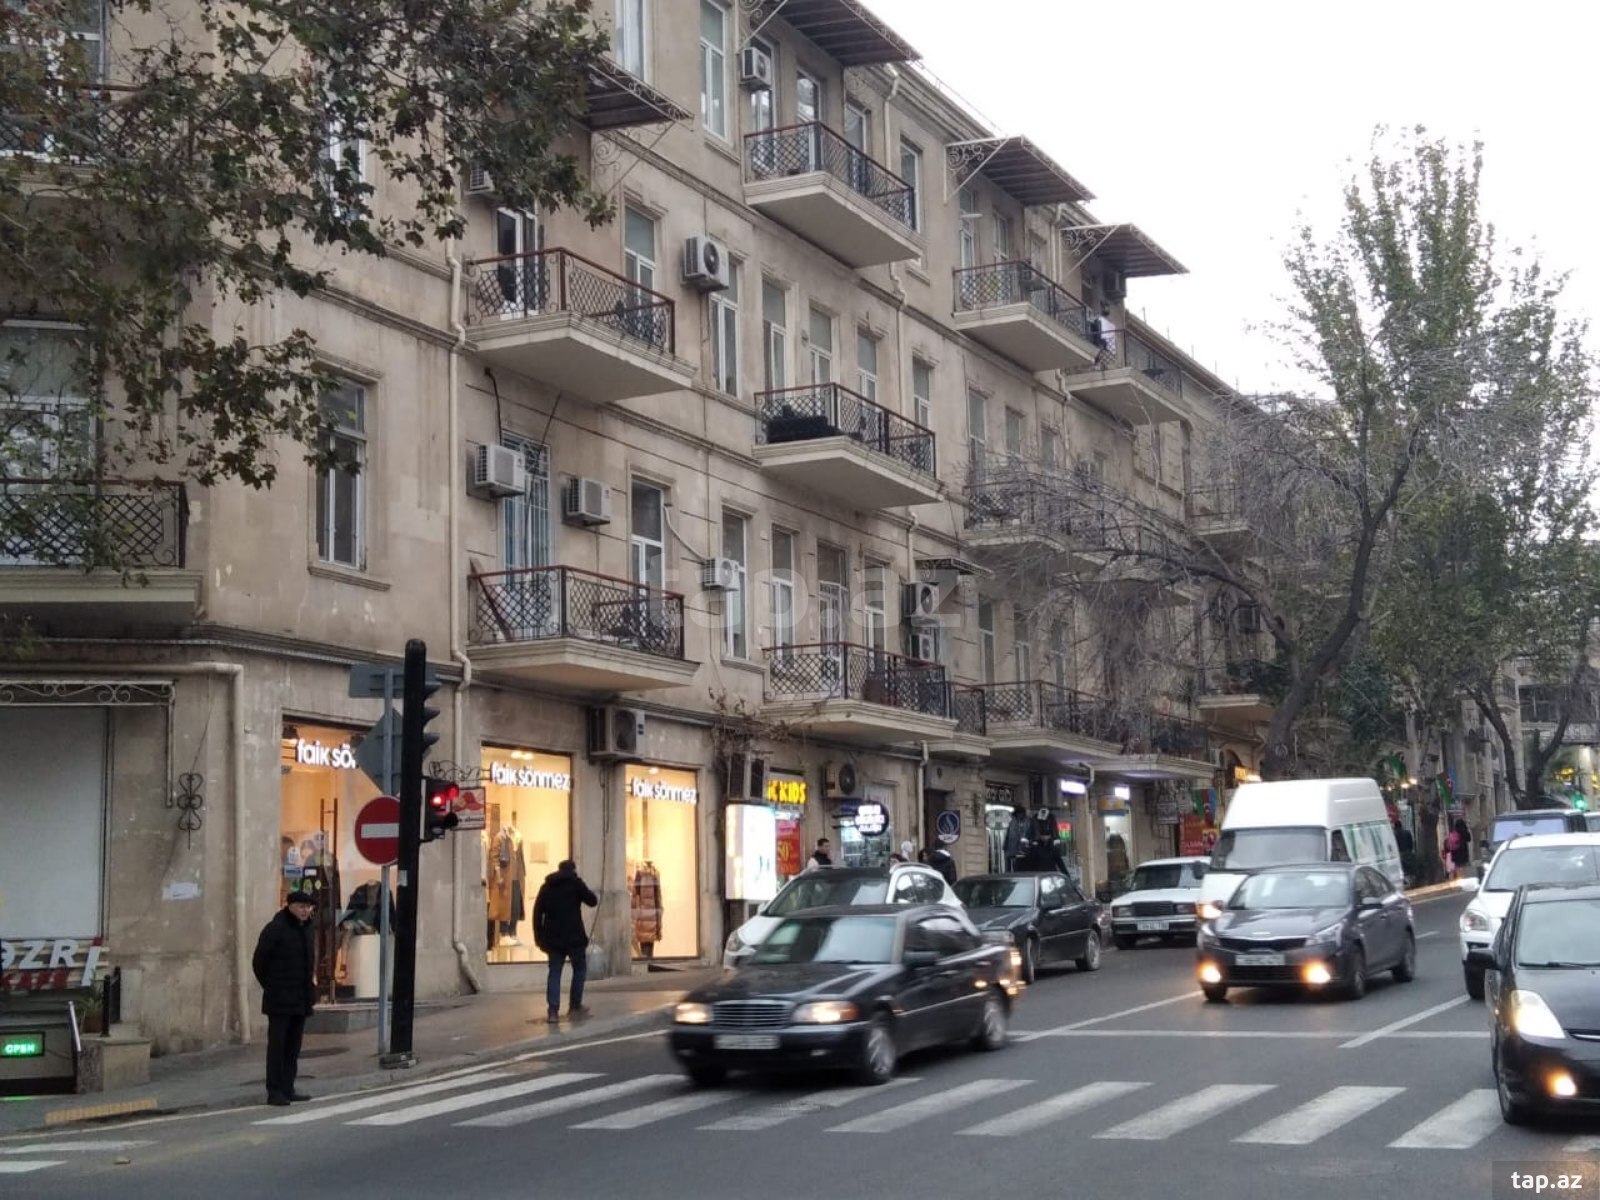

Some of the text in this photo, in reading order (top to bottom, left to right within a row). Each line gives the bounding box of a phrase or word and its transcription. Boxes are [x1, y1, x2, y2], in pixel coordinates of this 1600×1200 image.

[297, 738, 330, 767] faik
[491, 761, 570, 792] faik sönmez
[779, 781, 807, 804] KIDS
[4, 1042, 36, 1055] OPEN
